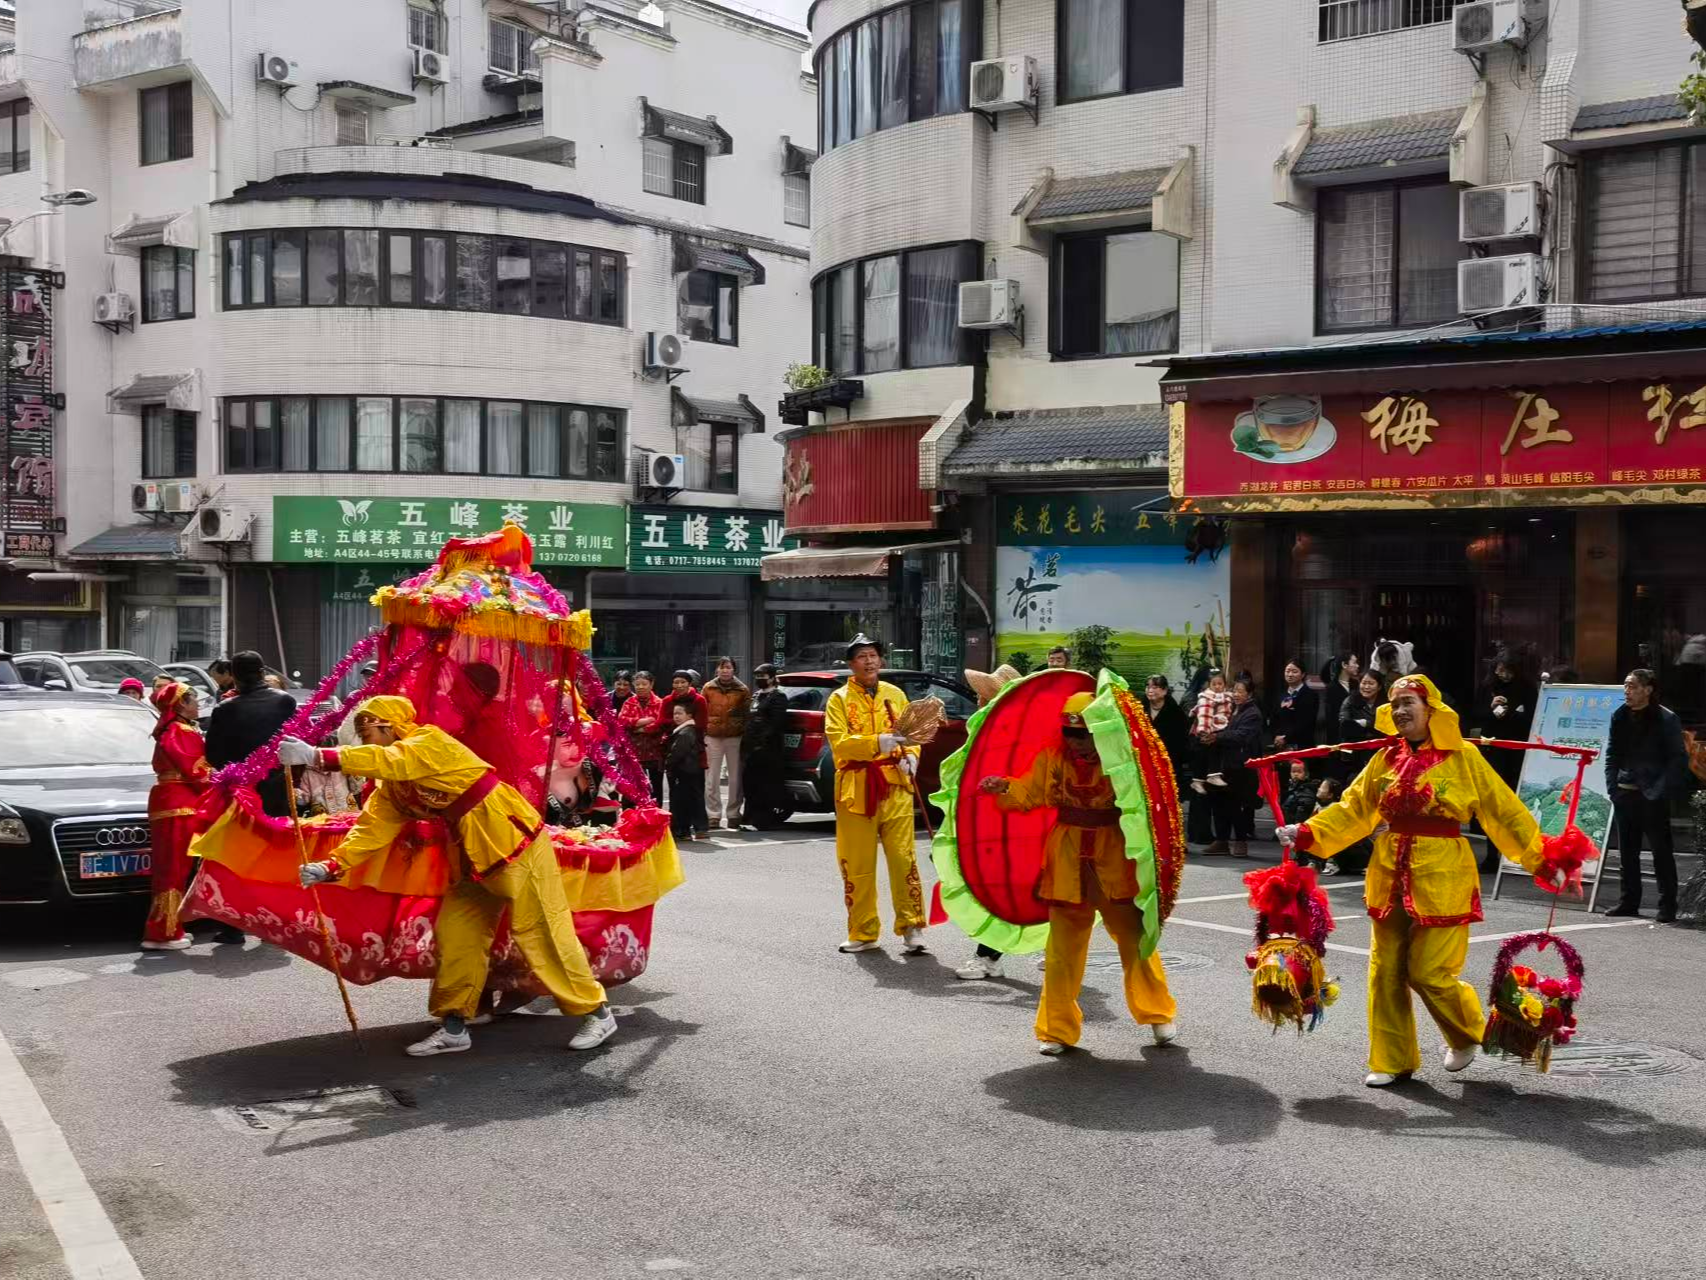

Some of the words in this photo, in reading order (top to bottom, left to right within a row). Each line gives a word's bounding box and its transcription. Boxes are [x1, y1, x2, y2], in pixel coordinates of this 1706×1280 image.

[1406, 476, 1447, 488] 六安瓜片
[398, 501, 573, 530] 五峰茶业
[336, 529, 402, 545] 五峰茗茶
[575, 536, 614, 550] 利川红
[641, 513, 785, 552] 五峰茶业
